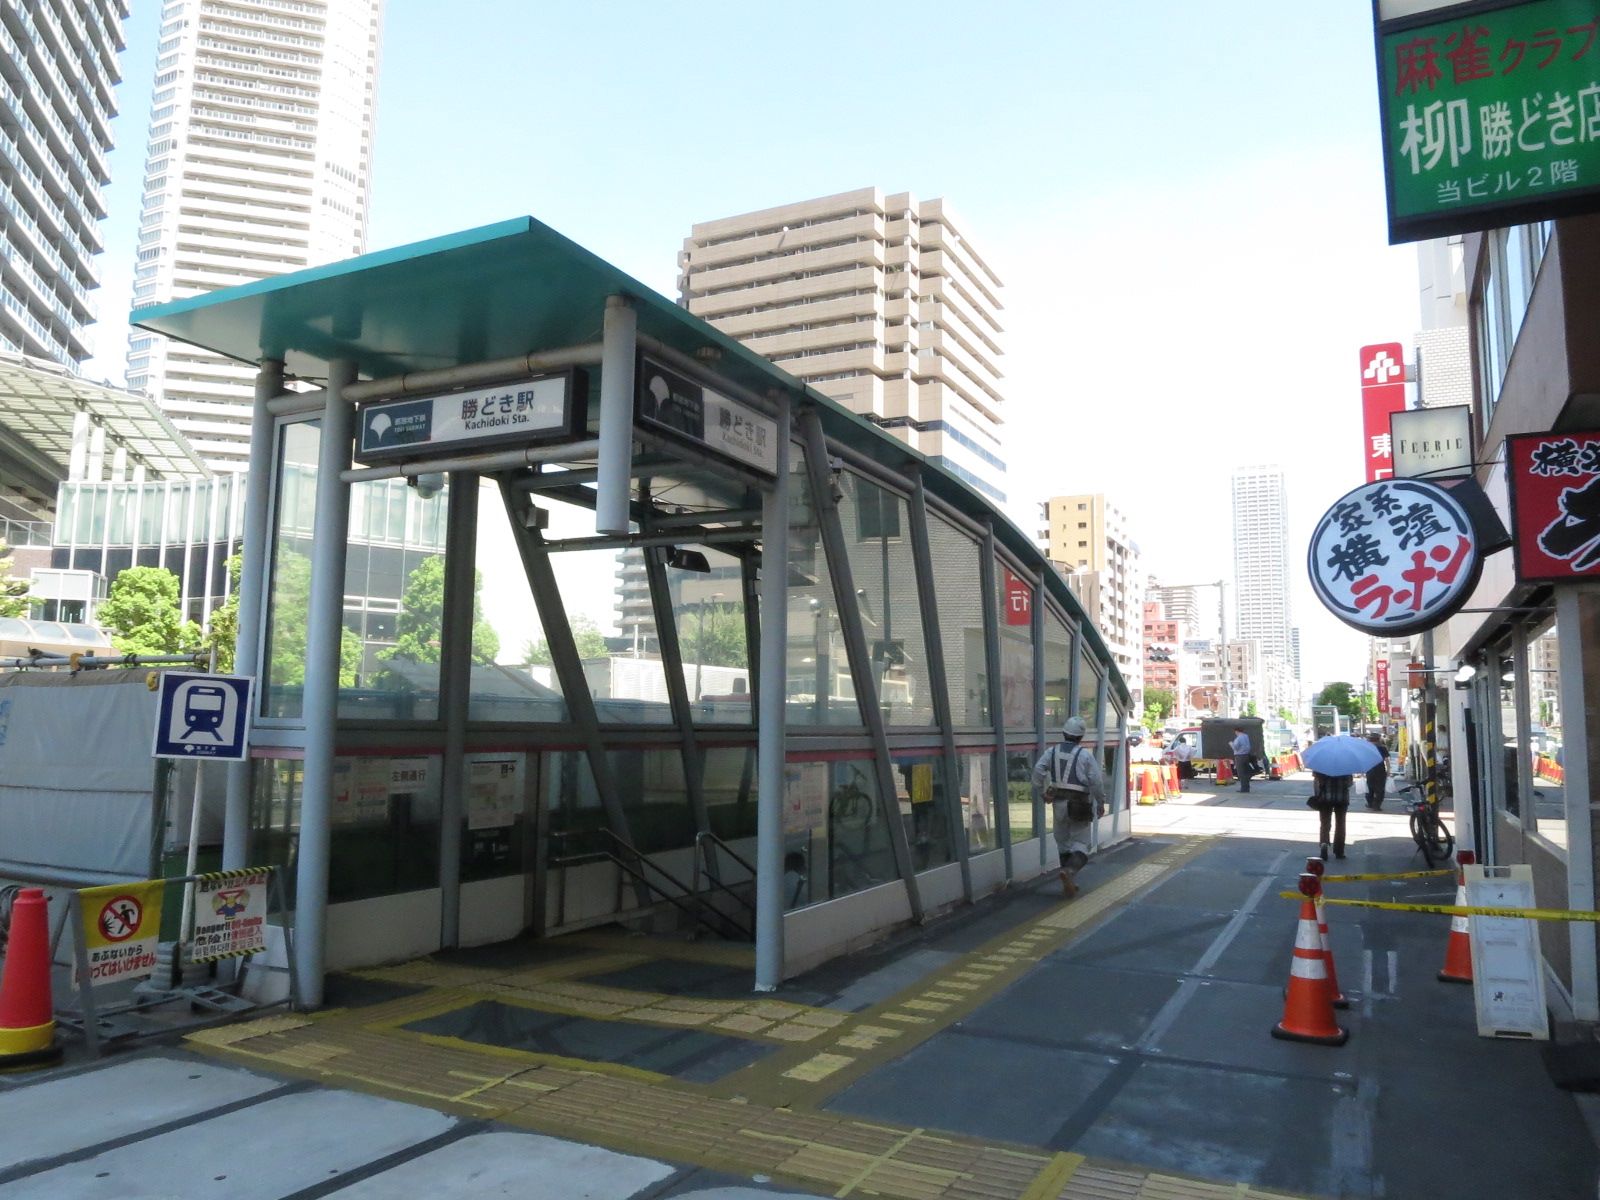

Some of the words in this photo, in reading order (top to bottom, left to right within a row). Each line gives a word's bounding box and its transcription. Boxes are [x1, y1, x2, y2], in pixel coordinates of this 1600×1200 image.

[461, 390, 535, 420] 勝どき駅
[464, 414, 510, 431] Kachidoki
[512, 413, 530, 424] Sta.
[1351, 535, 1471, 619] ラーメン
[92, 944, 143, 962] あぶないから
